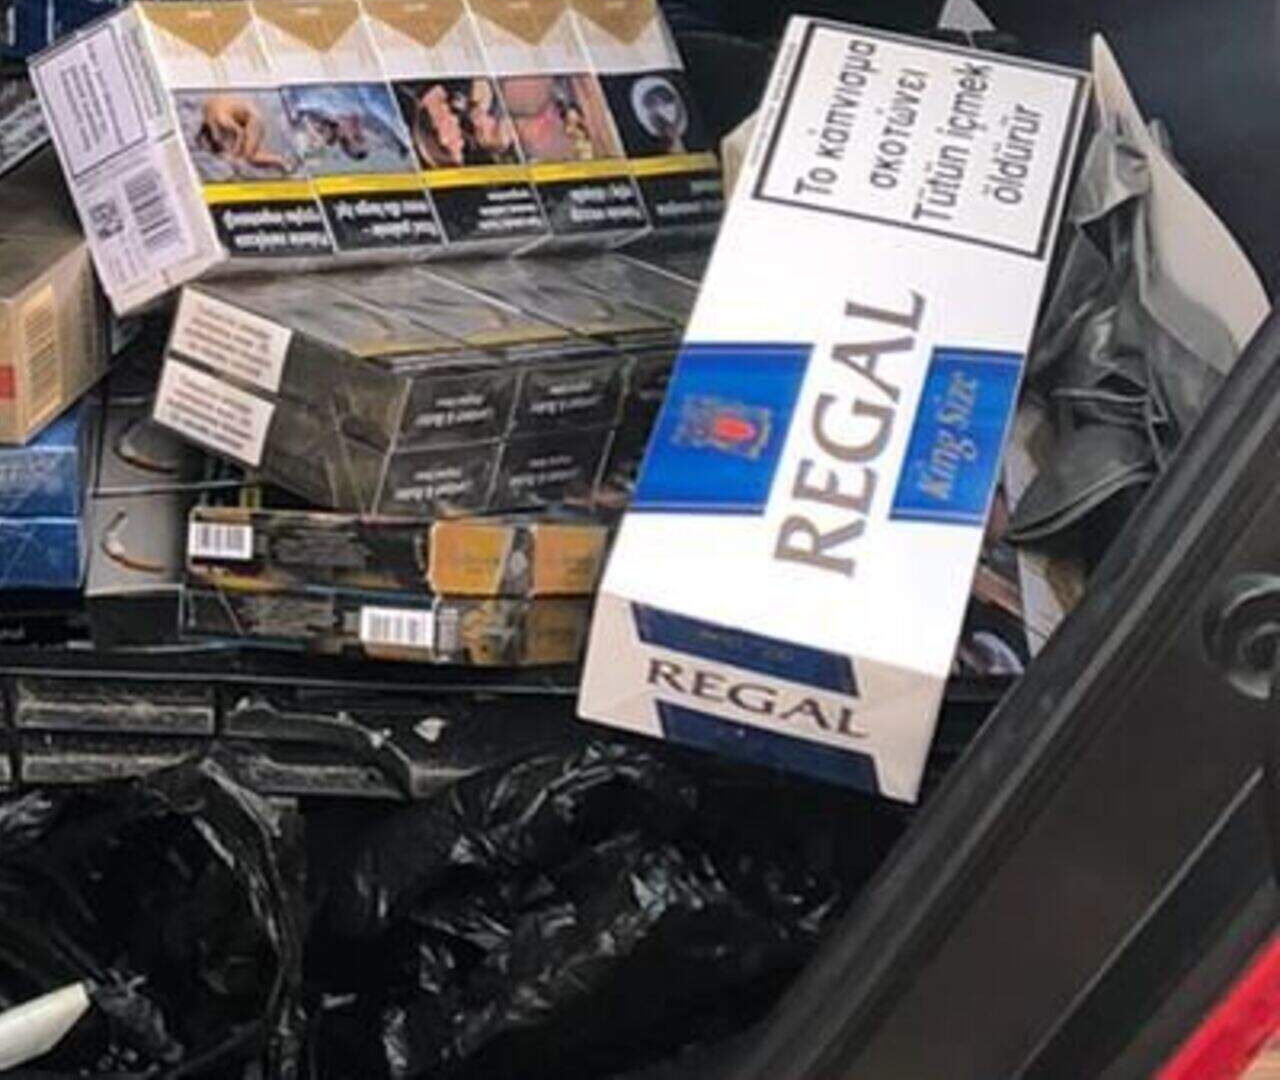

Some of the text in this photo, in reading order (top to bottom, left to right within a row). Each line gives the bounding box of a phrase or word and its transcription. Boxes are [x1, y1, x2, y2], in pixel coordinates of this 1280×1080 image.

[935, 61, 994, 141] içmek
[981, 103, 1042, 206] öldürür
[772, 290, 926, 578] REGAL
[915, 369, 979, 502] King Size
[645, 656, 869, 739] REGAL
